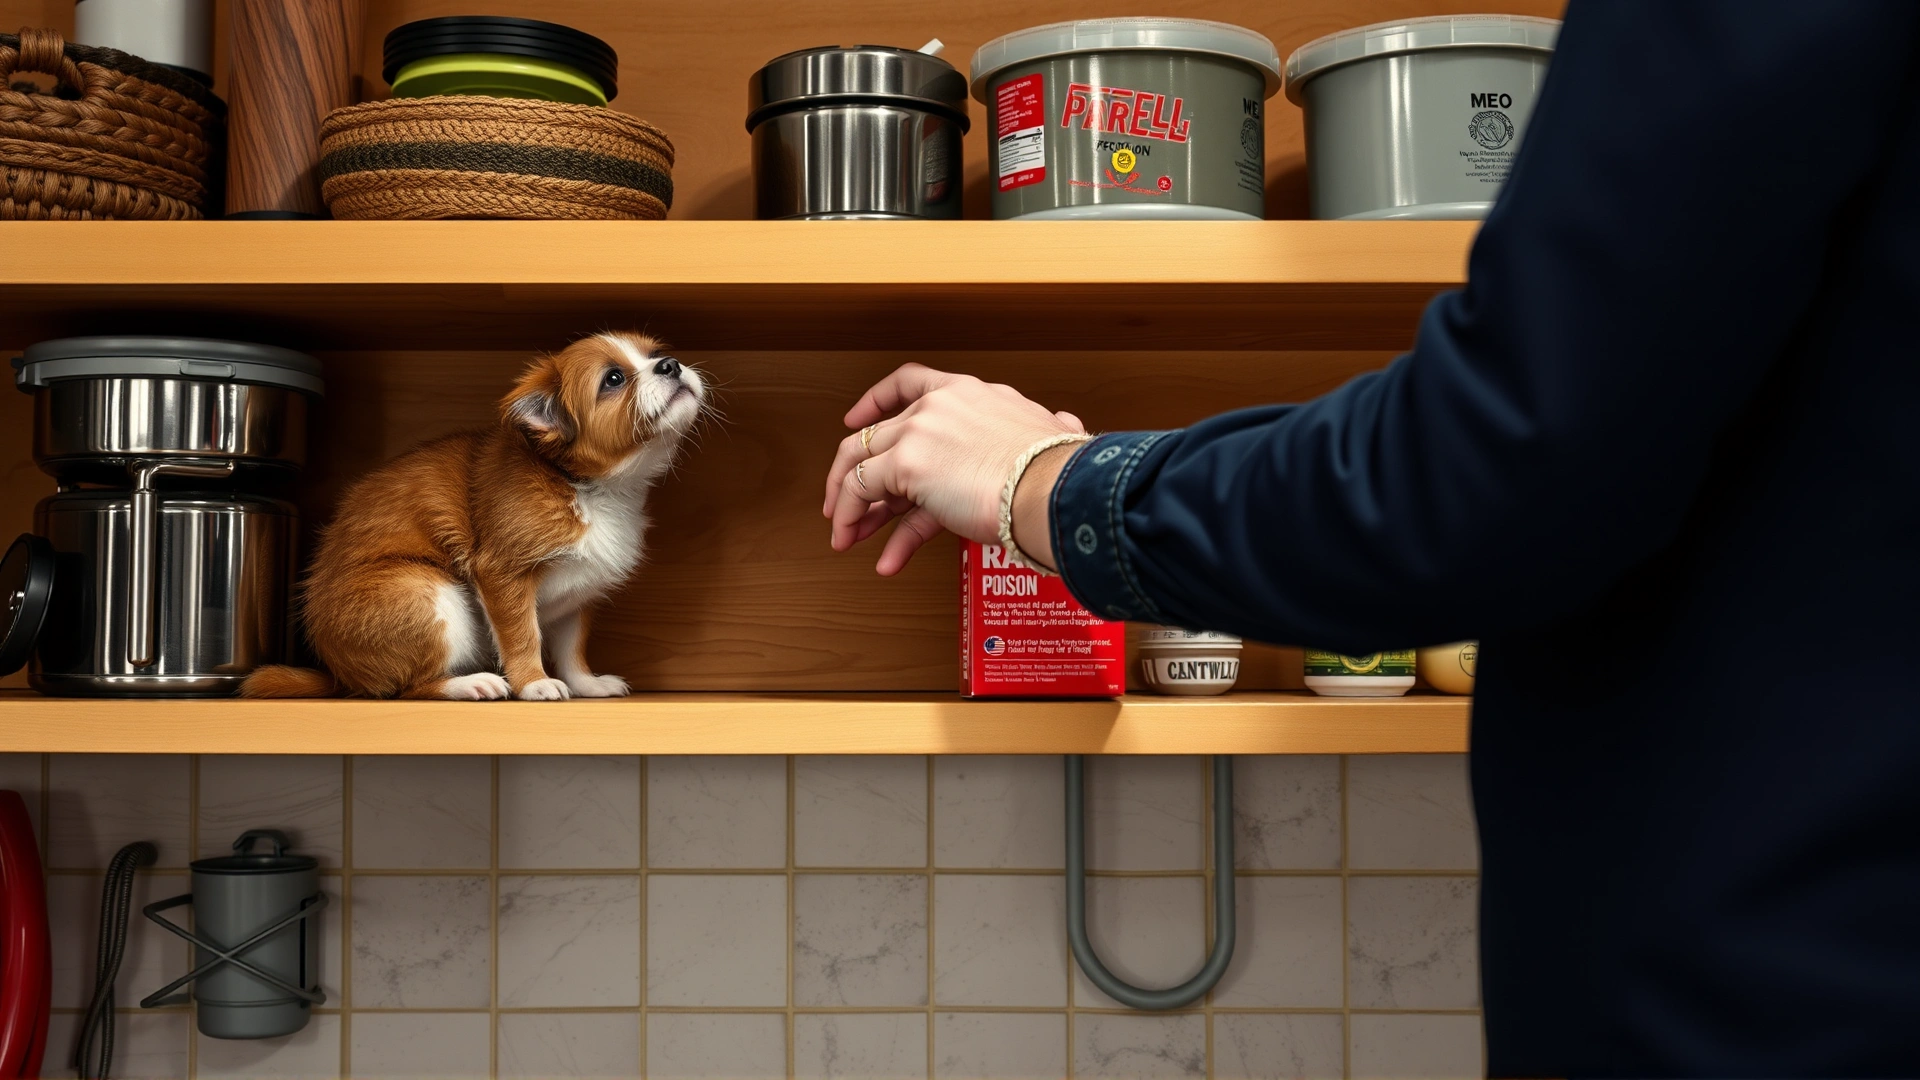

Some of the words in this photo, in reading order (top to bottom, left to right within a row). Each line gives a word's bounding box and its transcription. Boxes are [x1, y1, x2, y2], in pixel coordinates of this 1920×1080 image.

[1470, 92, 1512, 109] MEO
[982, 543, 1034, 569] RA
[982, 574, 1038, 596] POISON
